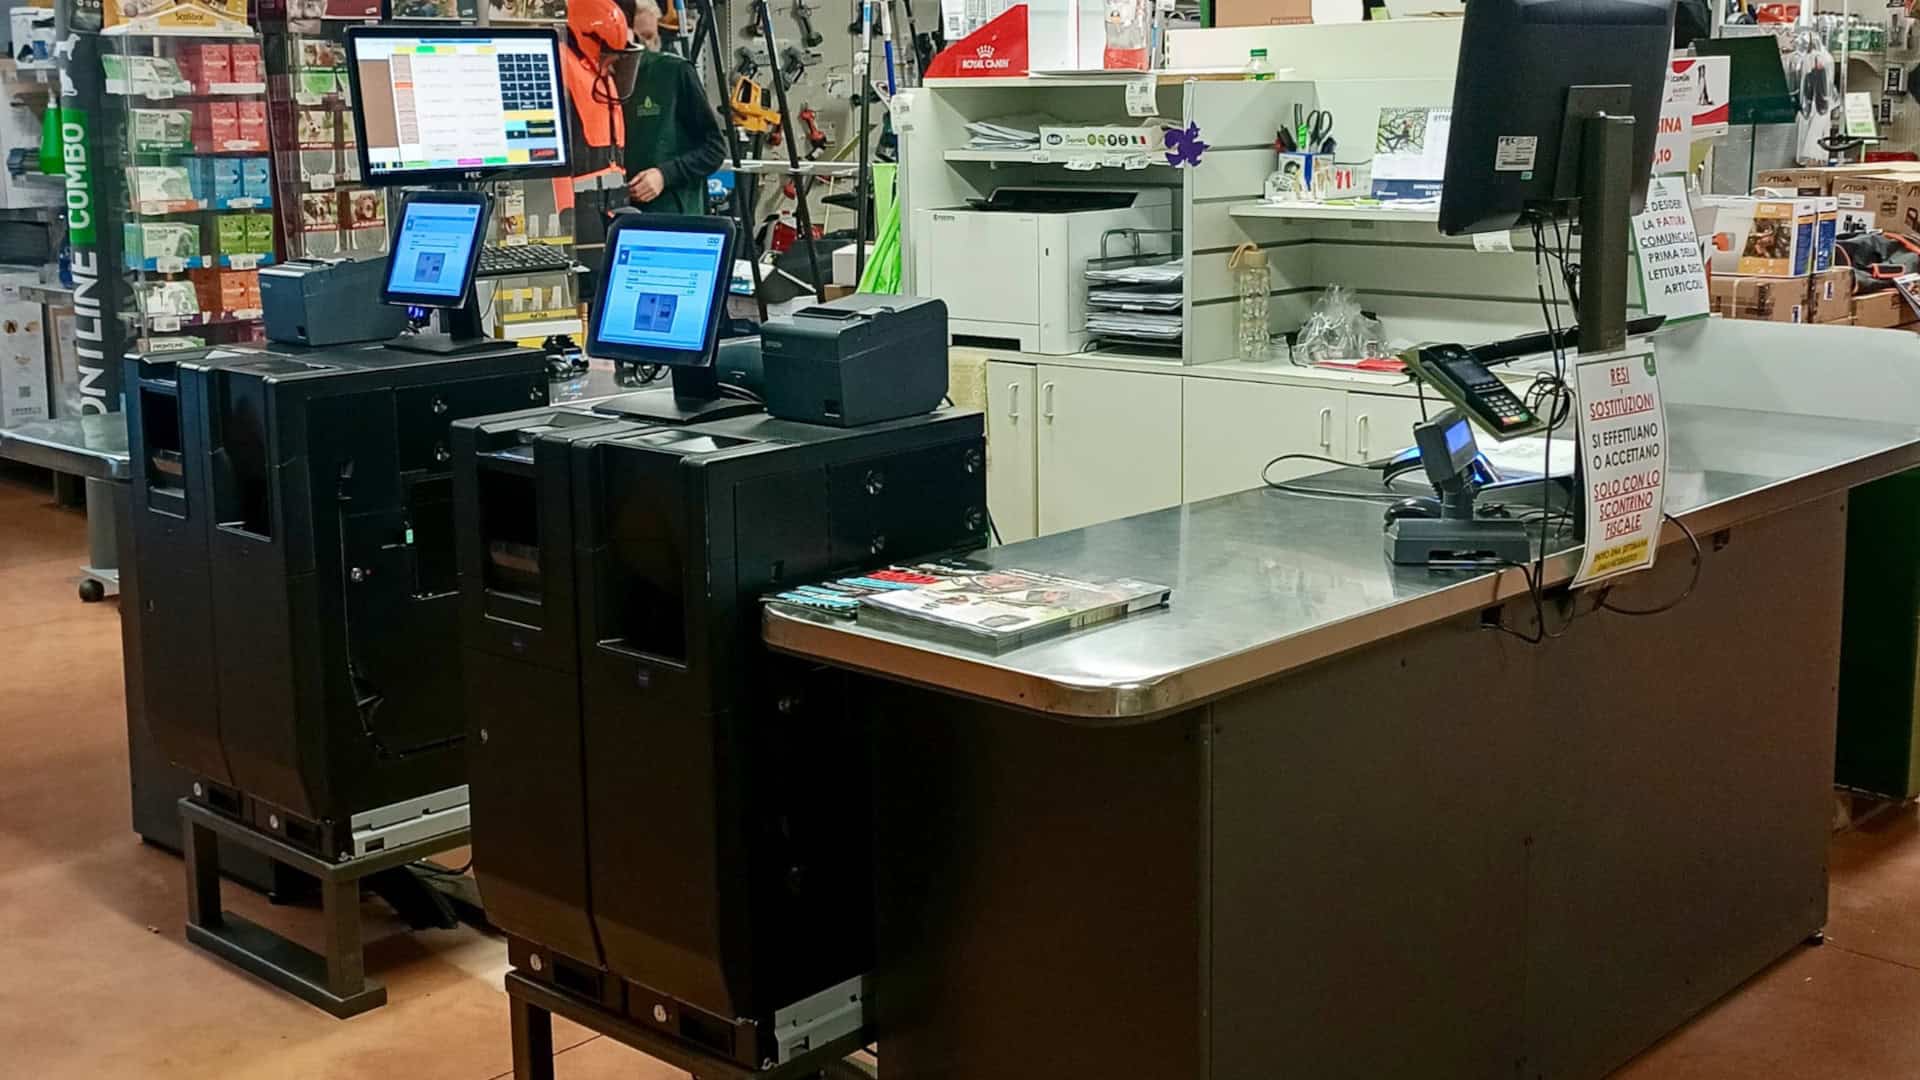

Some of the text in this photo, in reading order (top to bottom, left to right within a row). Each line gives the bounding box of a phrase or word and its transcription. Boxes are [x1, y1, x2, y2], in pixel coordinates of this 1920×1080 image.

[1656, 116, 1682, 133] INA
[62, 122, 91, 230] COMBO
[1643, 219, 1655, 231] LA
[1648, 249, 1679, 263] PRIMA
[1648, 264, 1688, 281] LETTURA
[1610, 366, 1630, 384] RESI
[1590, 393, 1655, 418] SOSTITUZIONI
[1592, 422, 1658, 449] SI EFFETTUANO
[1593, 443, 1660, 470] O ACCETTANO
[1594, 469, 1660, 500] SOLO CON LO
[1600, 491, 1653, 520] SCONTRINO
[1606, 514, 1642, 538] FISCALE
